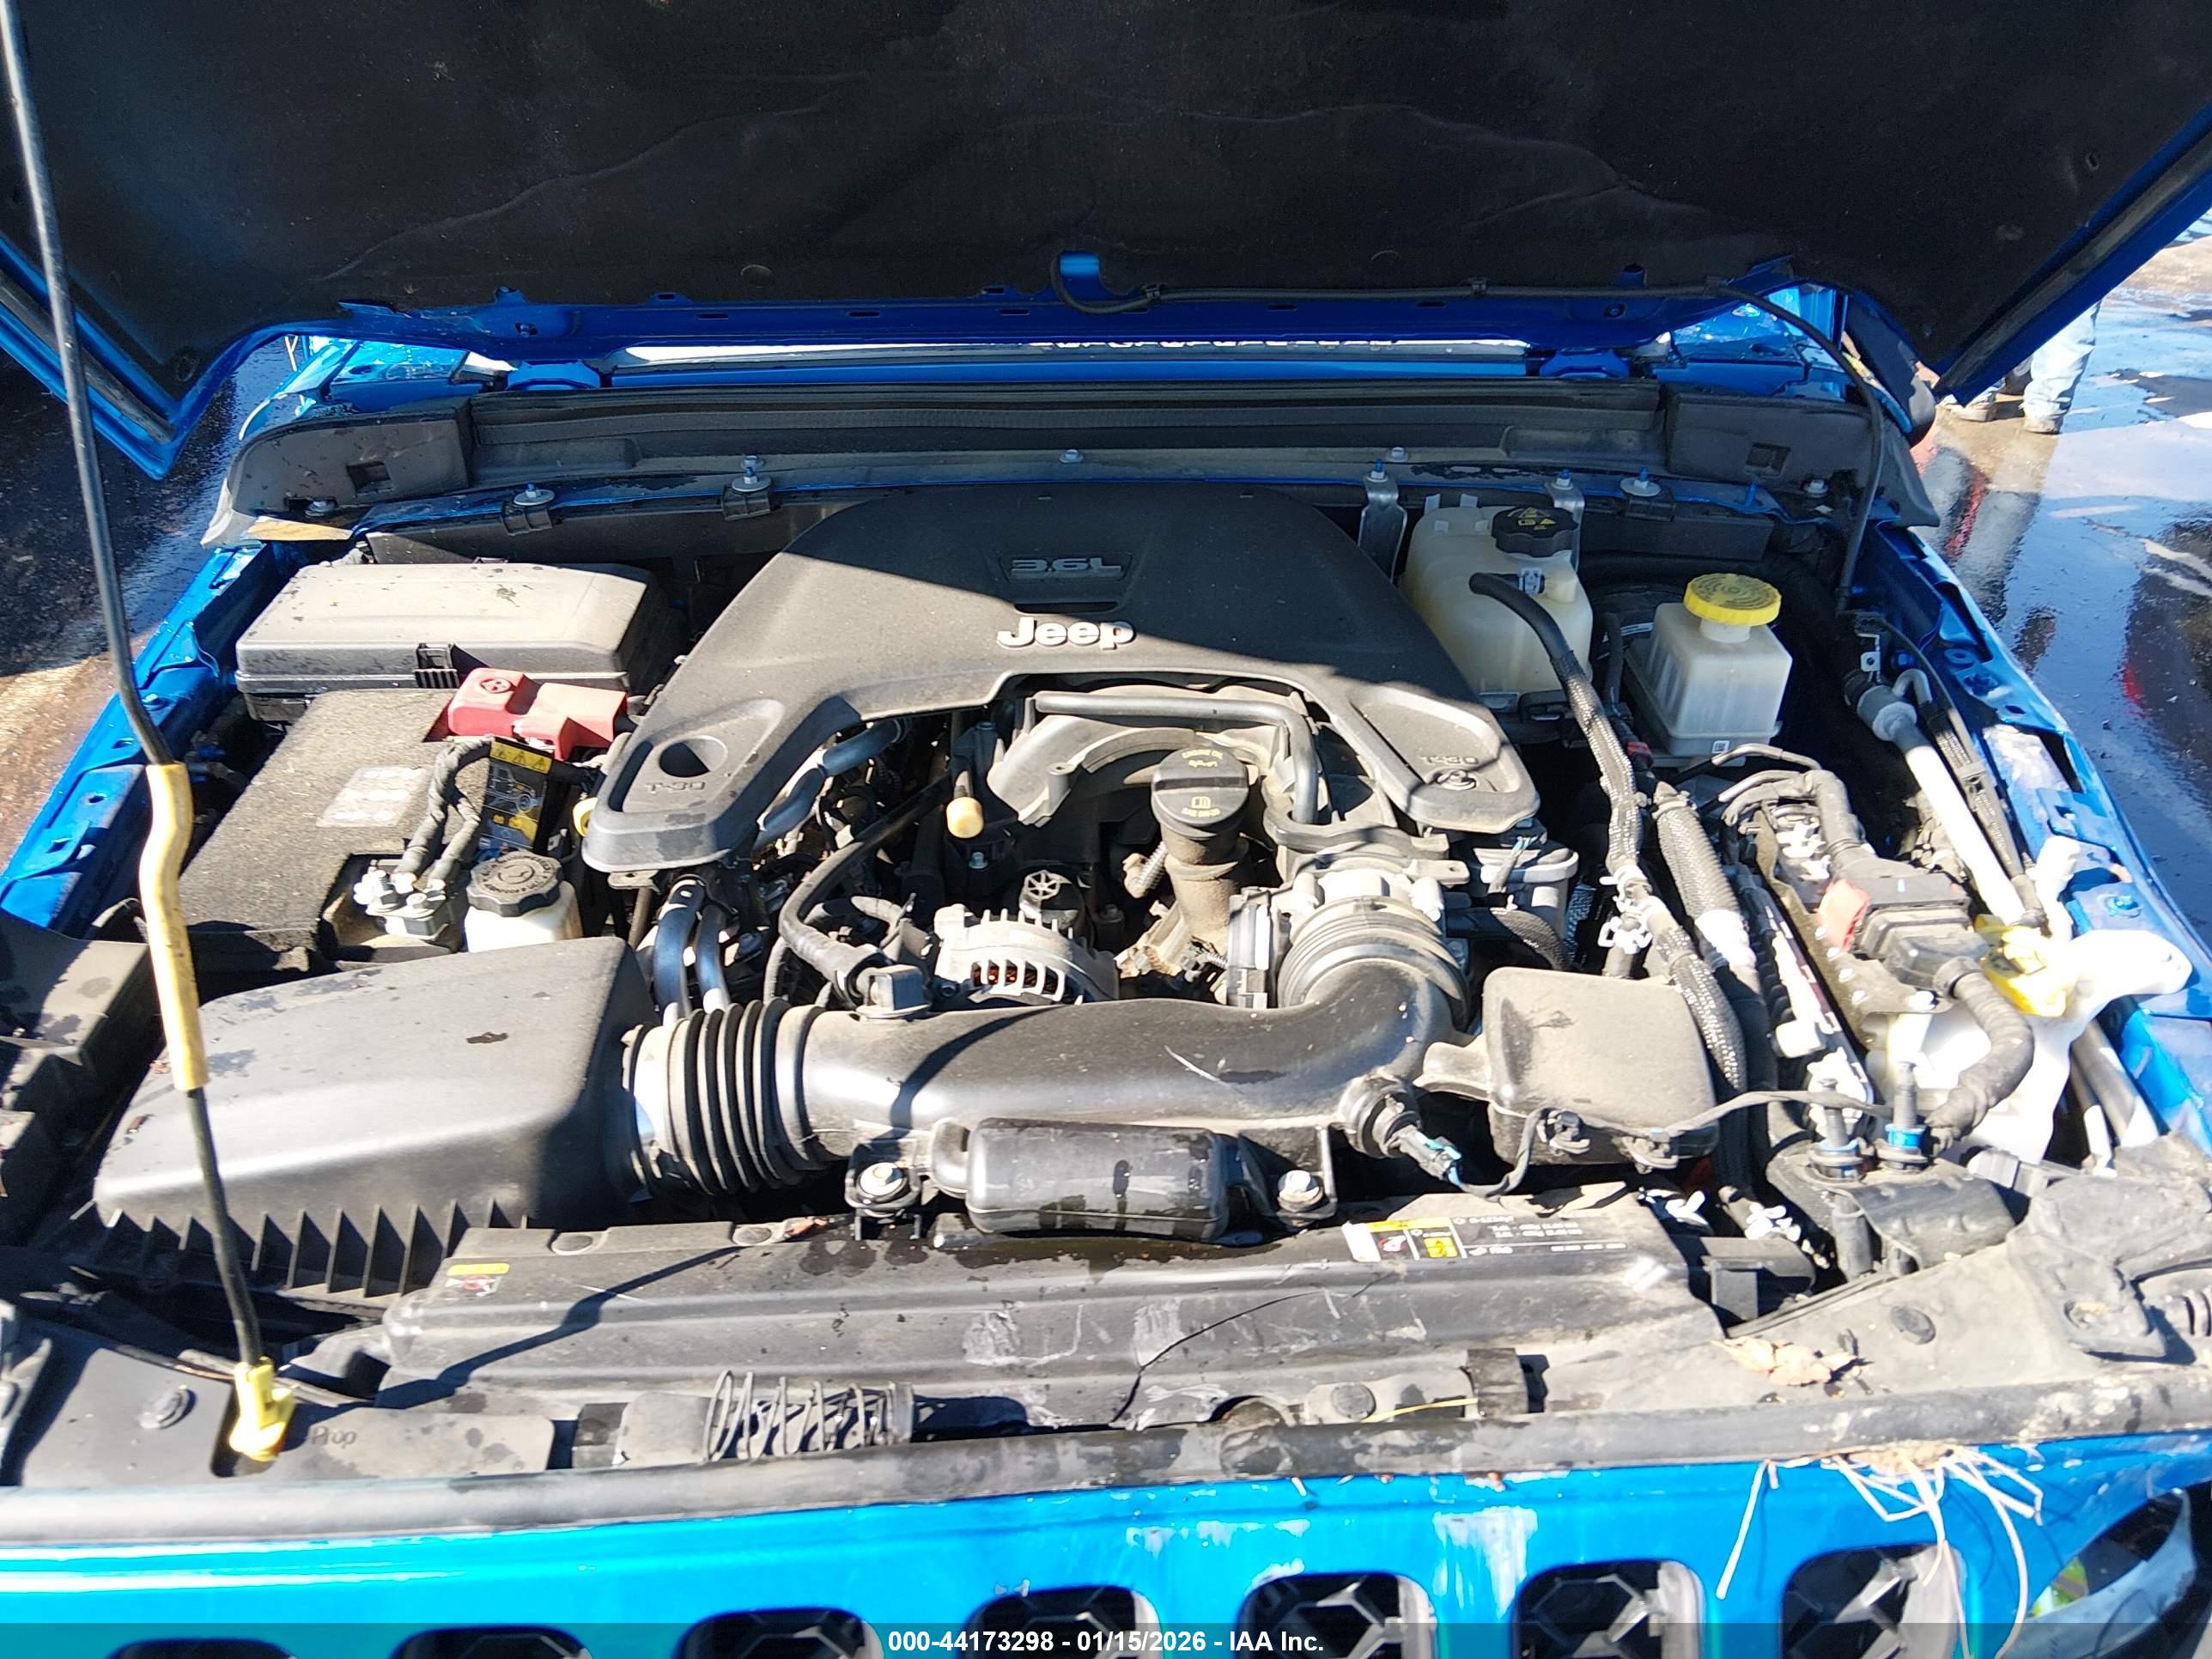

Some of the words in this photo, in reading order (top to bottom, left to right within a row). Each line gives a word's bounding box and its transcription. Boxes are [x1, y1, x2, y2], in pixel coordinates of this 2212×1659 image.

[1011, 556, 1122, 577] 3.6L
[996, 616, 1136, 651] Jeep
[310, 1425, 358, 1449] Prop
